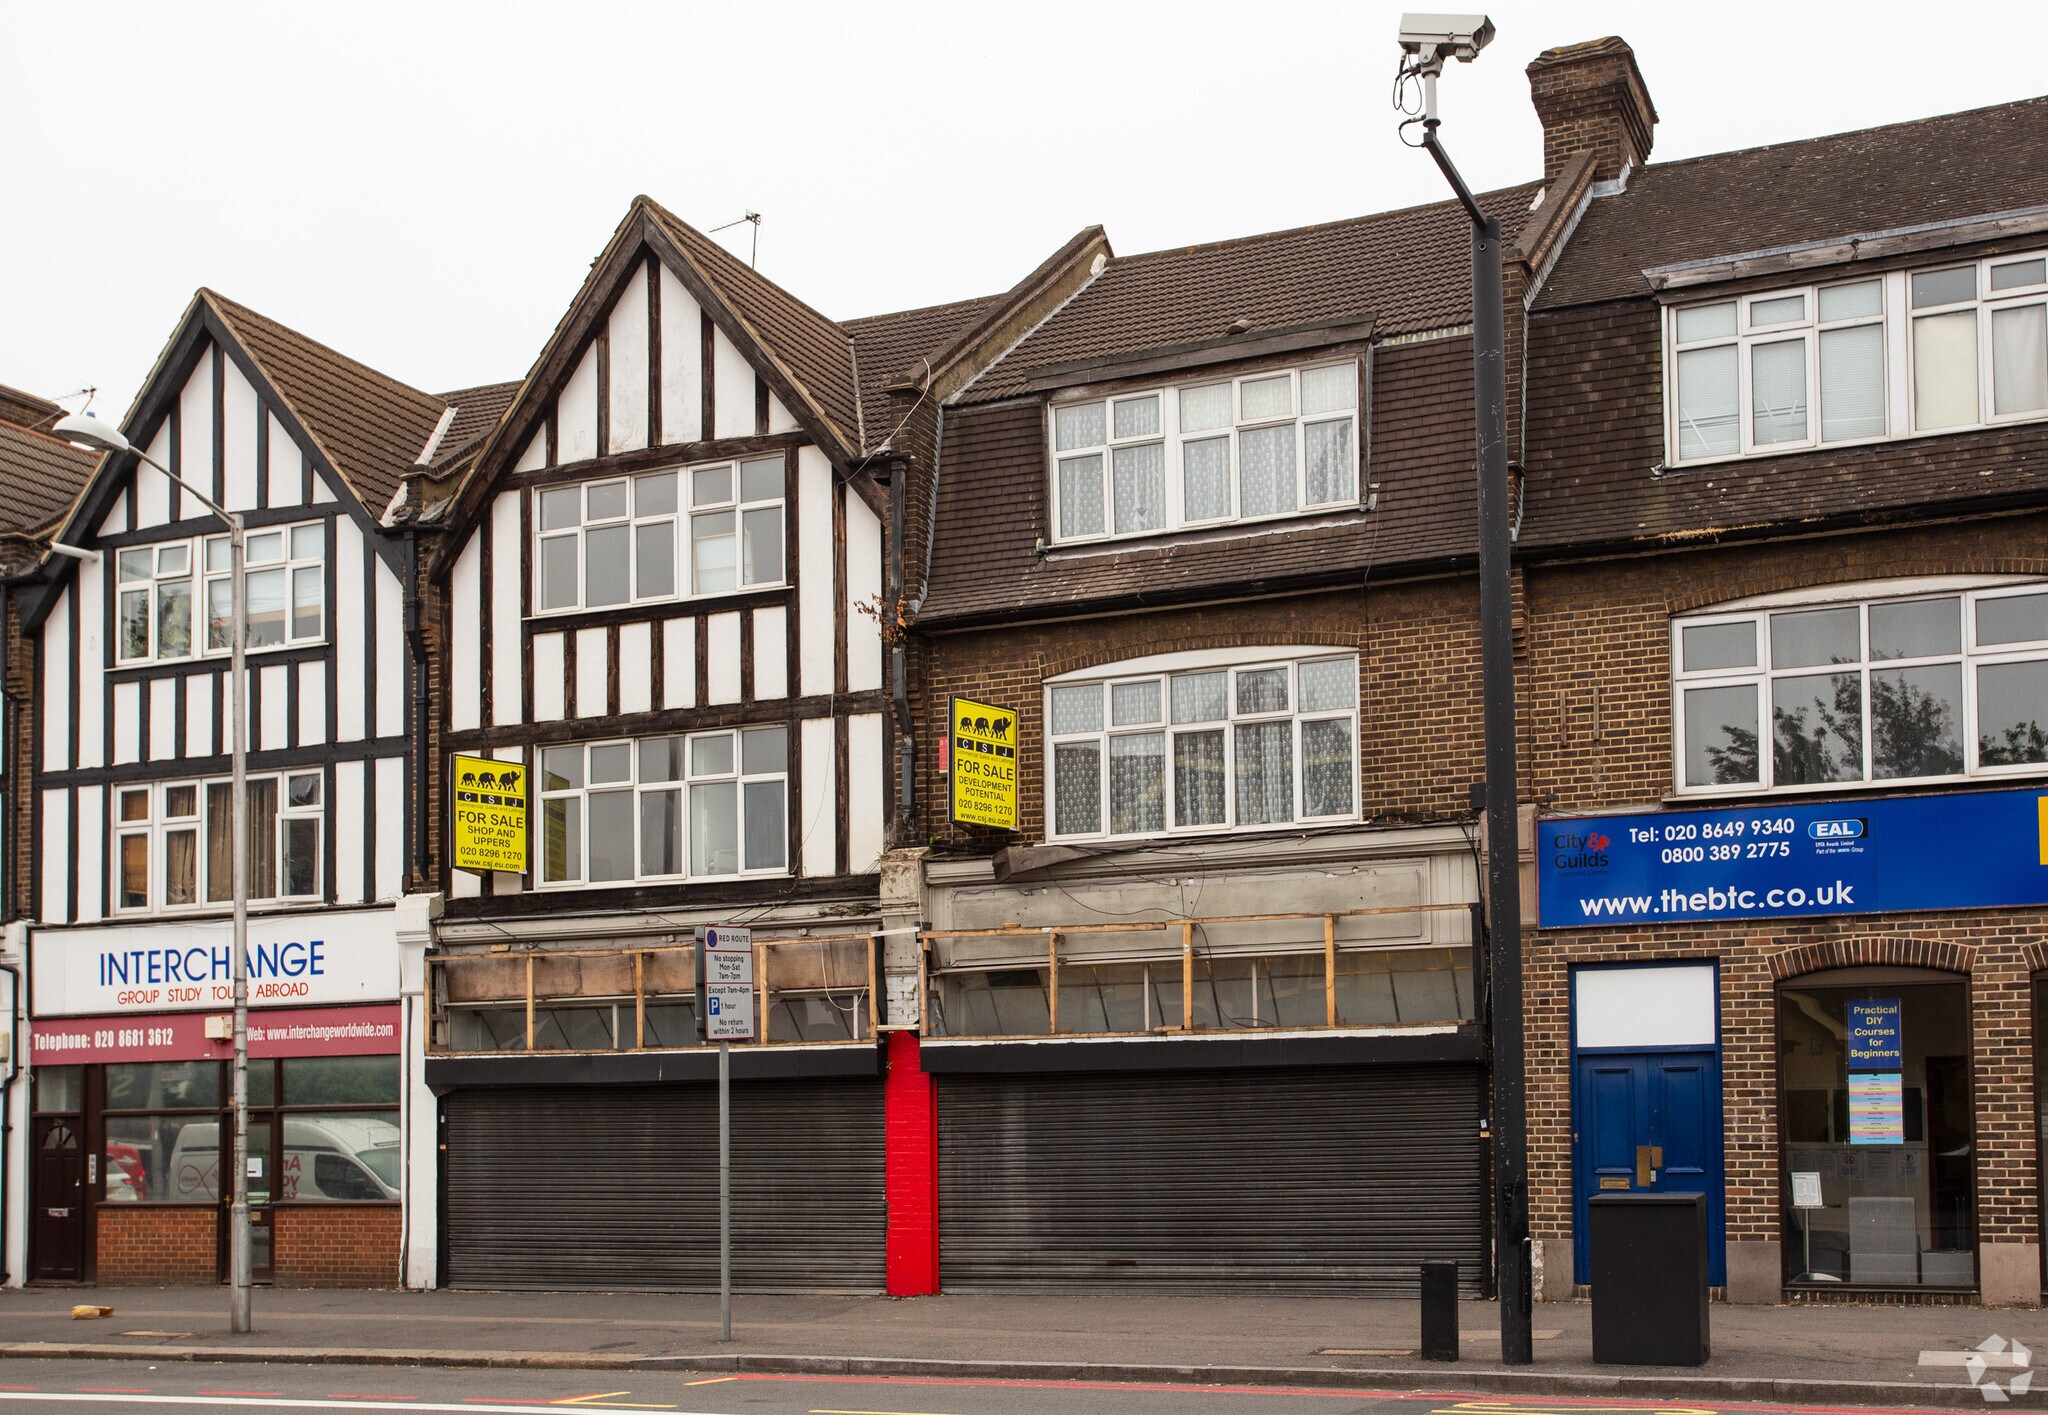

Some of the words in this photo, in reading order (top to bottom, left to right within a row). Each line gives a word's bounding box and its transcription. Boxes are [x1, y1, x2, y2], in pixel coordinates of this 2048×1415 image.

[957, 758, 980, 775] FOR
[983, 763, 1014, 781] SALE
[958, 775, 1013, 793] DEVELOPMENT
[965, 787, 1006, 802] POTENTIAL
[958, 798, 973, 810] 020
[974, 801, 993, 812] 8296
[994, 804, 1013, 816] 1270
[458, 810, 486, 825] FOR
[490, 813, 524, 829] SALE
[960, 812, 1011, 826] www.csj.eu.com
[467, 825, 494, 836] SHOP
[496, 828, 516, 839] AND
[1629, 827, 1660, 844] Tel:
[1664, 824, 1697, 842] 020
[1702, 821, 1745, 840] 8649
[1751, 818, 1795, 836] 9340
[1816, 822, 1854, 837] EAL
[473, 837, 511, 848] UPPERS
[1554, 834, 1588, 853] City
[460, 846, 477, 855] 020
[478, 848, 500, 858] 8296
[502, 850, 522, 860] 1270
[1661, 847, 1704, 864] 0800
[1709, 844, 1741, 862] 389
[1746, 841, 1790, 860] 2775
[462, 858, 520, 870] www.csj.eu.com
[1554, 853, 1609, 869] Guilds
[1580, 880, 1854, 917] www.thebtc.co.uk
[718, 934, 730, 942] RED
[731, 935, 749, 943] ROUTE
[117, 989, 160, 1005] GROUP
[168, 987, 203, 1002] STUDY
[211, 983, 249, 1000] TOUS
[256, 982, 309, 998] ABROAD
[1853, 1005, 1898, 1014] Practical
[1866, 1016, 1883, 1025] DIY
[246, 1026, 266, 1041] Web:
[266, 1022, 394, 1041] www.interchangeworldwide.com
[1854, 1027, 1895, 1036] Courses
[34, 1032, 91, 1051] Telephone:
[94, 1030, 115, 1048] 020
[118, 1029, 144, 1047] 8681
[147, 1028, 174, 1046] 3612
[1869, 1038, 1884, 1047] for
[1851, 1049, 1900, 1059] Beginners
